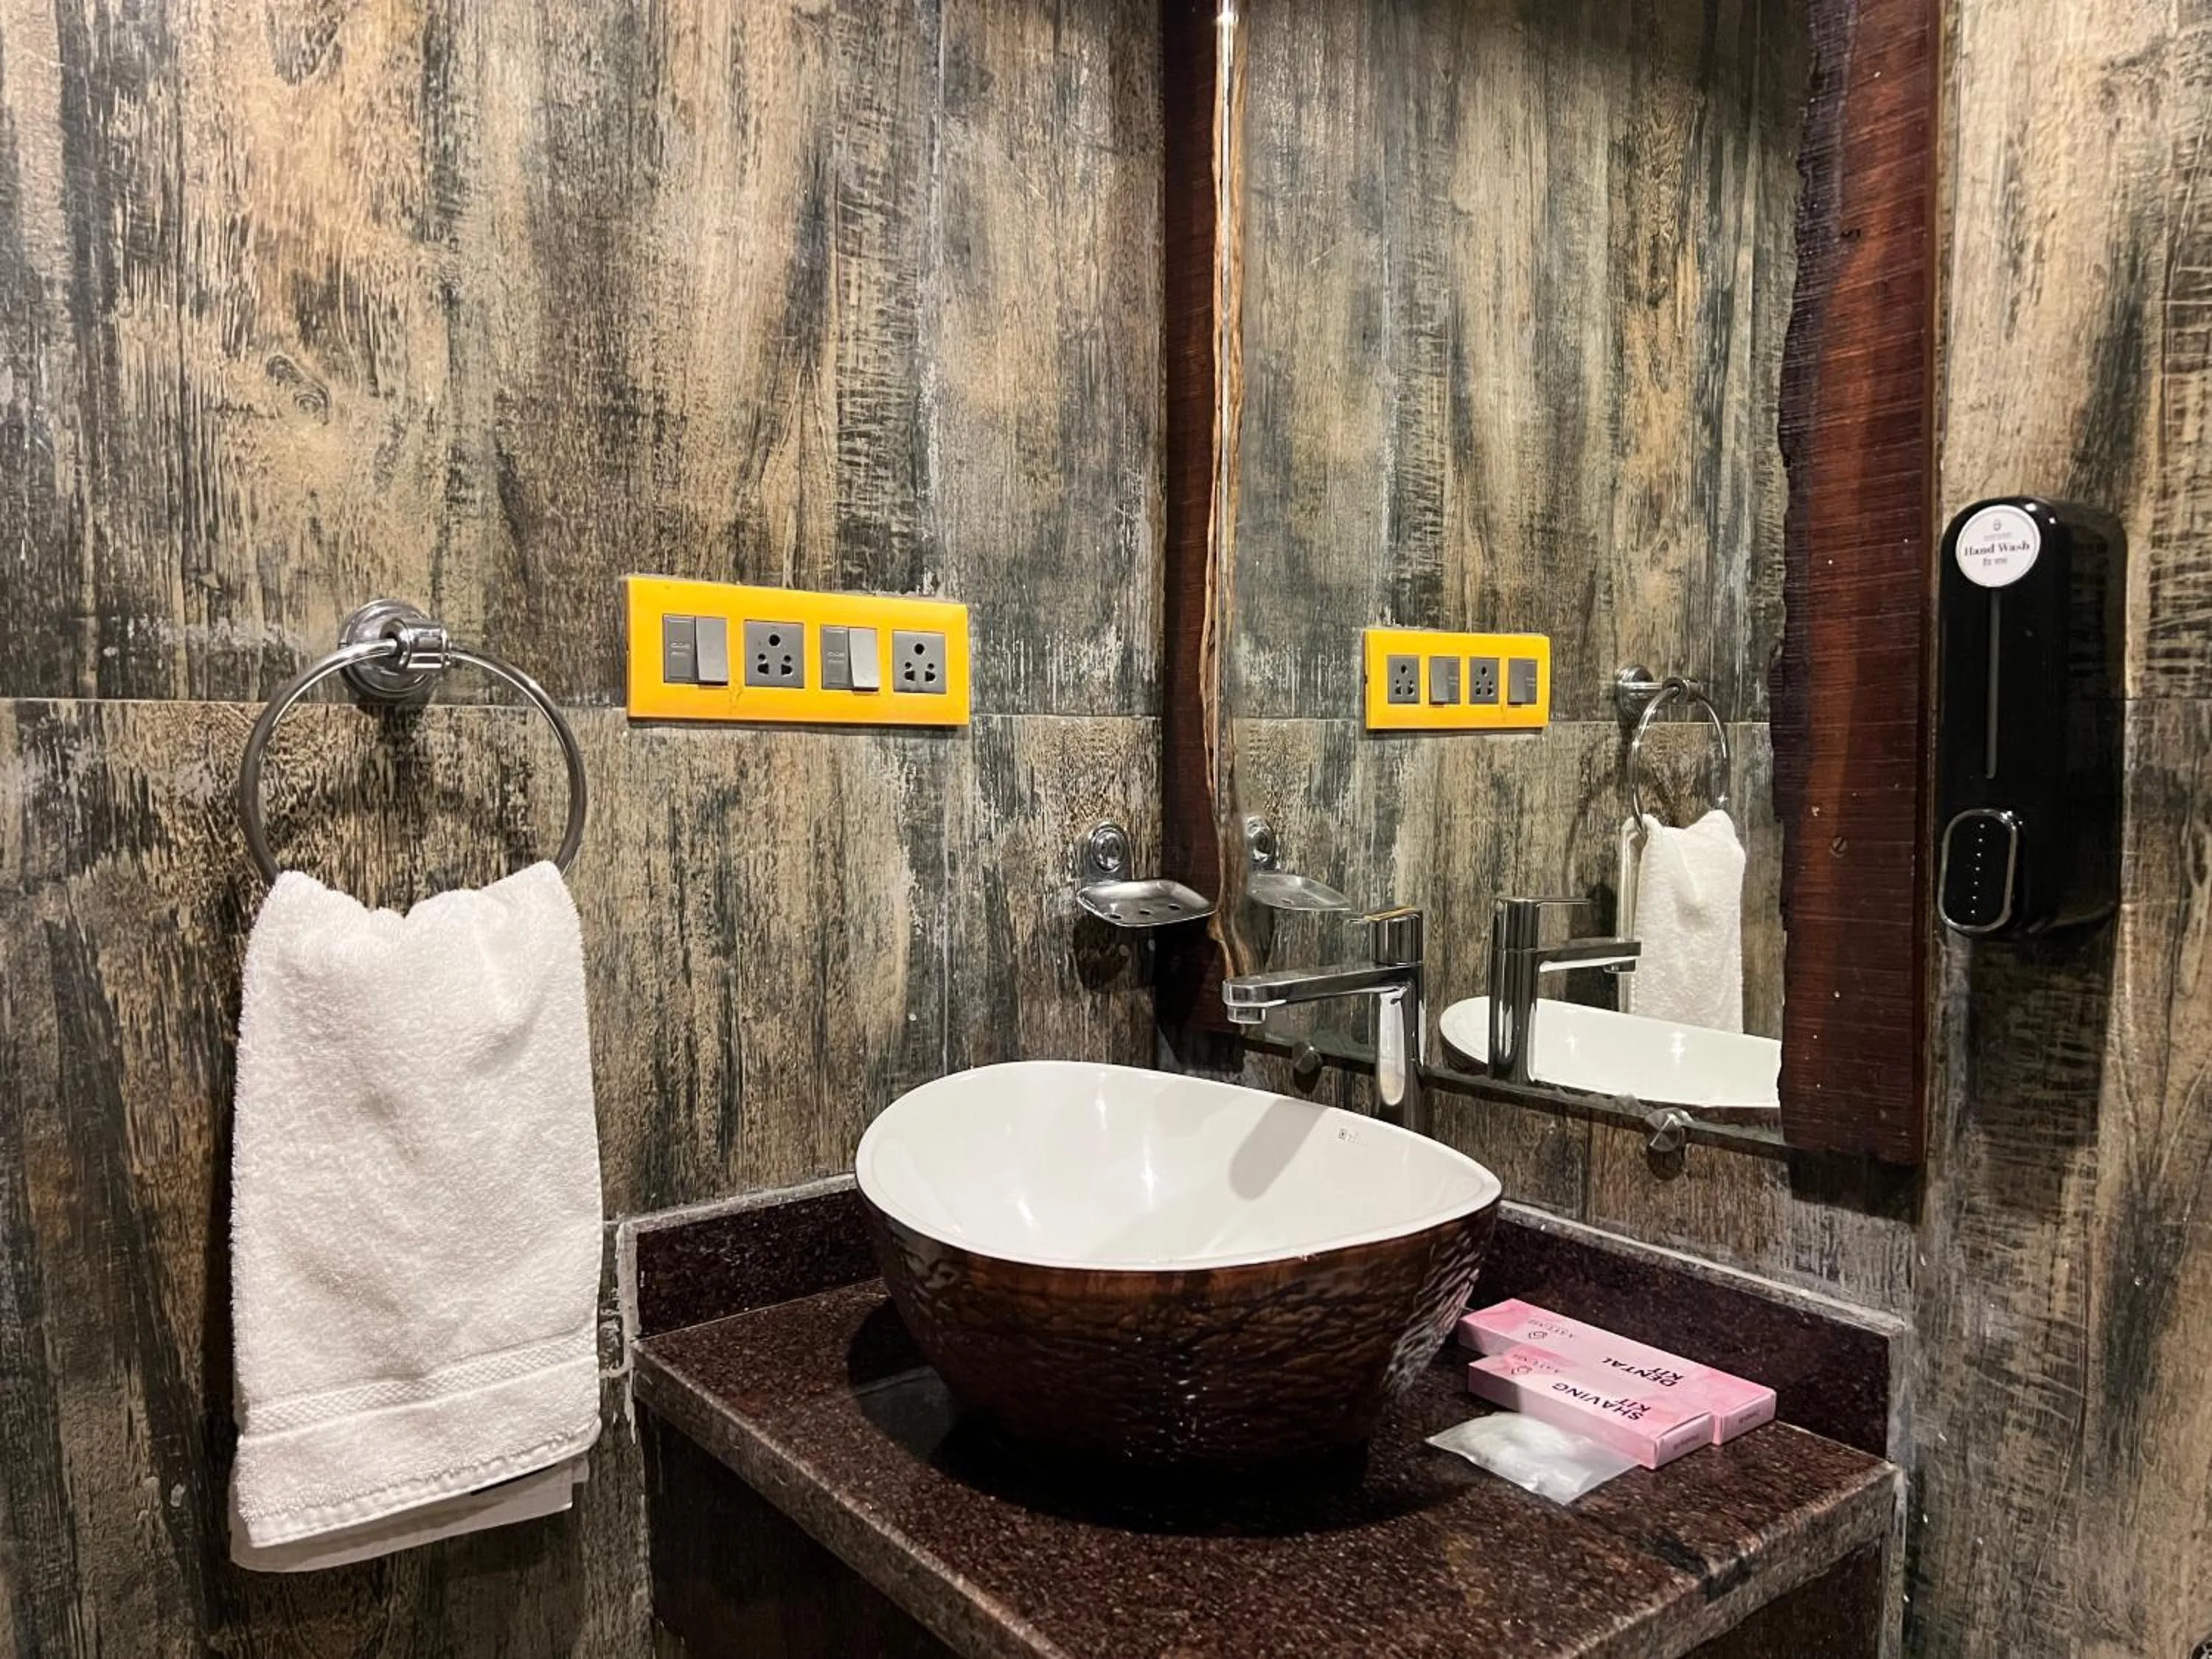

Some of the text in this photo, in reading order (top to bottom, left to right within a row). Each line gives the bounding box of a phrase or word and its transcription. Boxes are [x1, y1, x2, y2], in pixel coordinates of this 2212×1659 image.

[1964, 540, 2030, 556] Hand Wash
[1601, 1357, 1677, 1387] DENTAL
[1648, 1368, 1684, 1381] KIT
[1552, 1382, 1644, 1421] SHAVING
[1616, 1399, 1651, 1413] KIT
